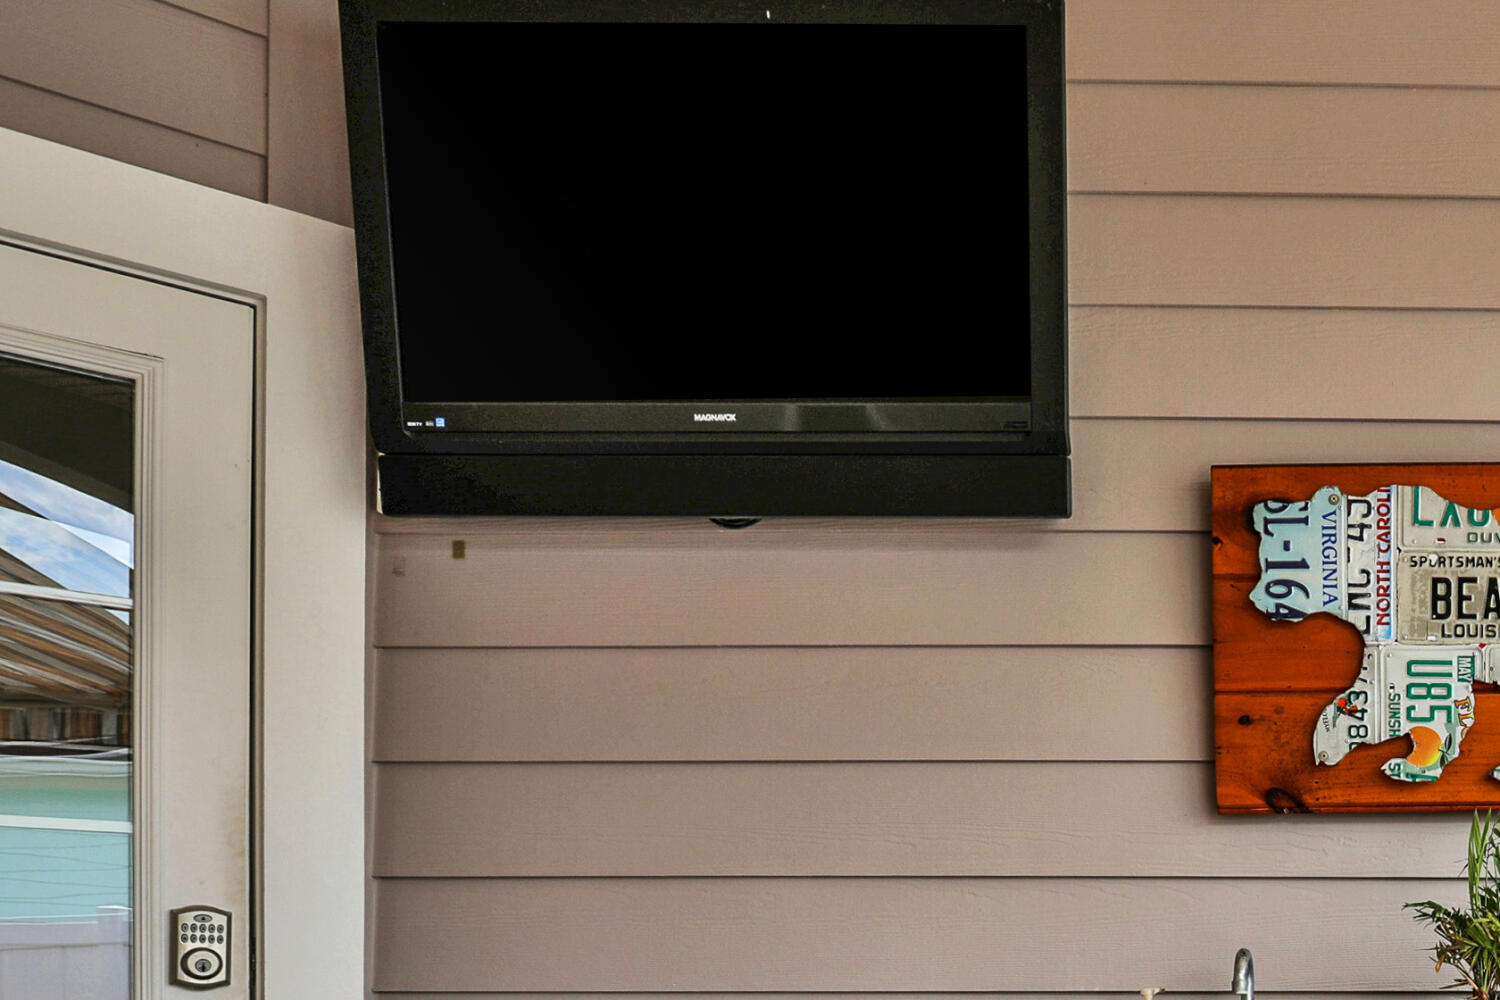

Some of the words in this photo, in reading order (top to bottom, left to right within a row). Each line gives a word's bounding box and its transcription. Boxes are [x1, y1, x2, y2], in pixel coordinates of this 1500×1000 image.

[694, 413, 736, 421] MAGNAVOX
[1321, 510, 1339, 607] VIRGINIA
[1376, 562, 1391, 626] NORTH
[1407, 660, 1454, 723] U85
[1457, 657, 1472, 681] MAY
